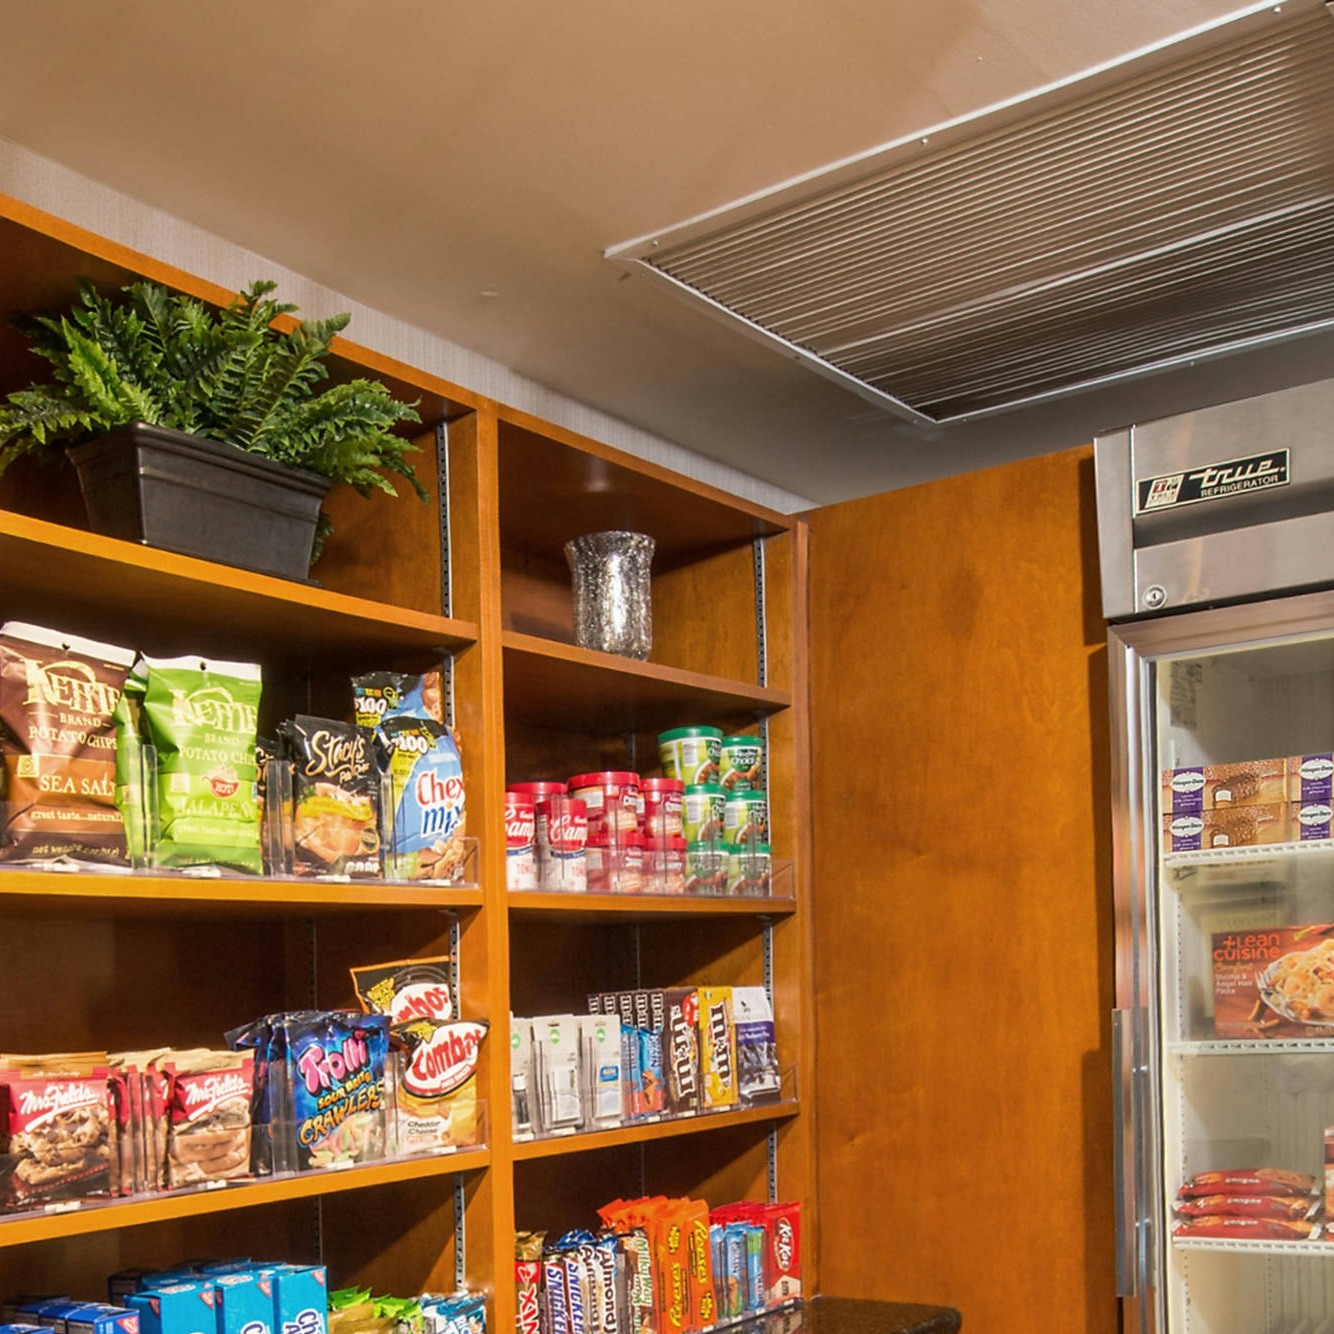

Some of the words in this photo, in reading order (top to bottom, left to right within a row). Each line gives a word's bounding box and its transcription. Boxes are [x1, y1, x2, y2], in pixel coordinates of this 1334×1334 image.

[1200, 474, 1279, 498] REFRIGERATOR
[59, 711, 103, 727] BRAND
[28, 725, 85, 747] POTATO
[178, 745, 228, 762] POTATO
[305, 729, 368, 777] Stacy's
[39, 773, 74, 794] SEA
[417, 771, 465, 806] Chex
[1237, 933, 1280, 947] Lean
[1213, 946, 1281, 961] cuisine
[298, 1029, 368, 1094] Trolli
[317, 1087, 346, 1110] SOUR
[298, 1079, 386, 1148] CRAWLERS
[406, 1119, 441, 1129] Cheddar
[406, 1127, 439, 1136] Cheese
[598, 1248, 617, 1325] Almond
